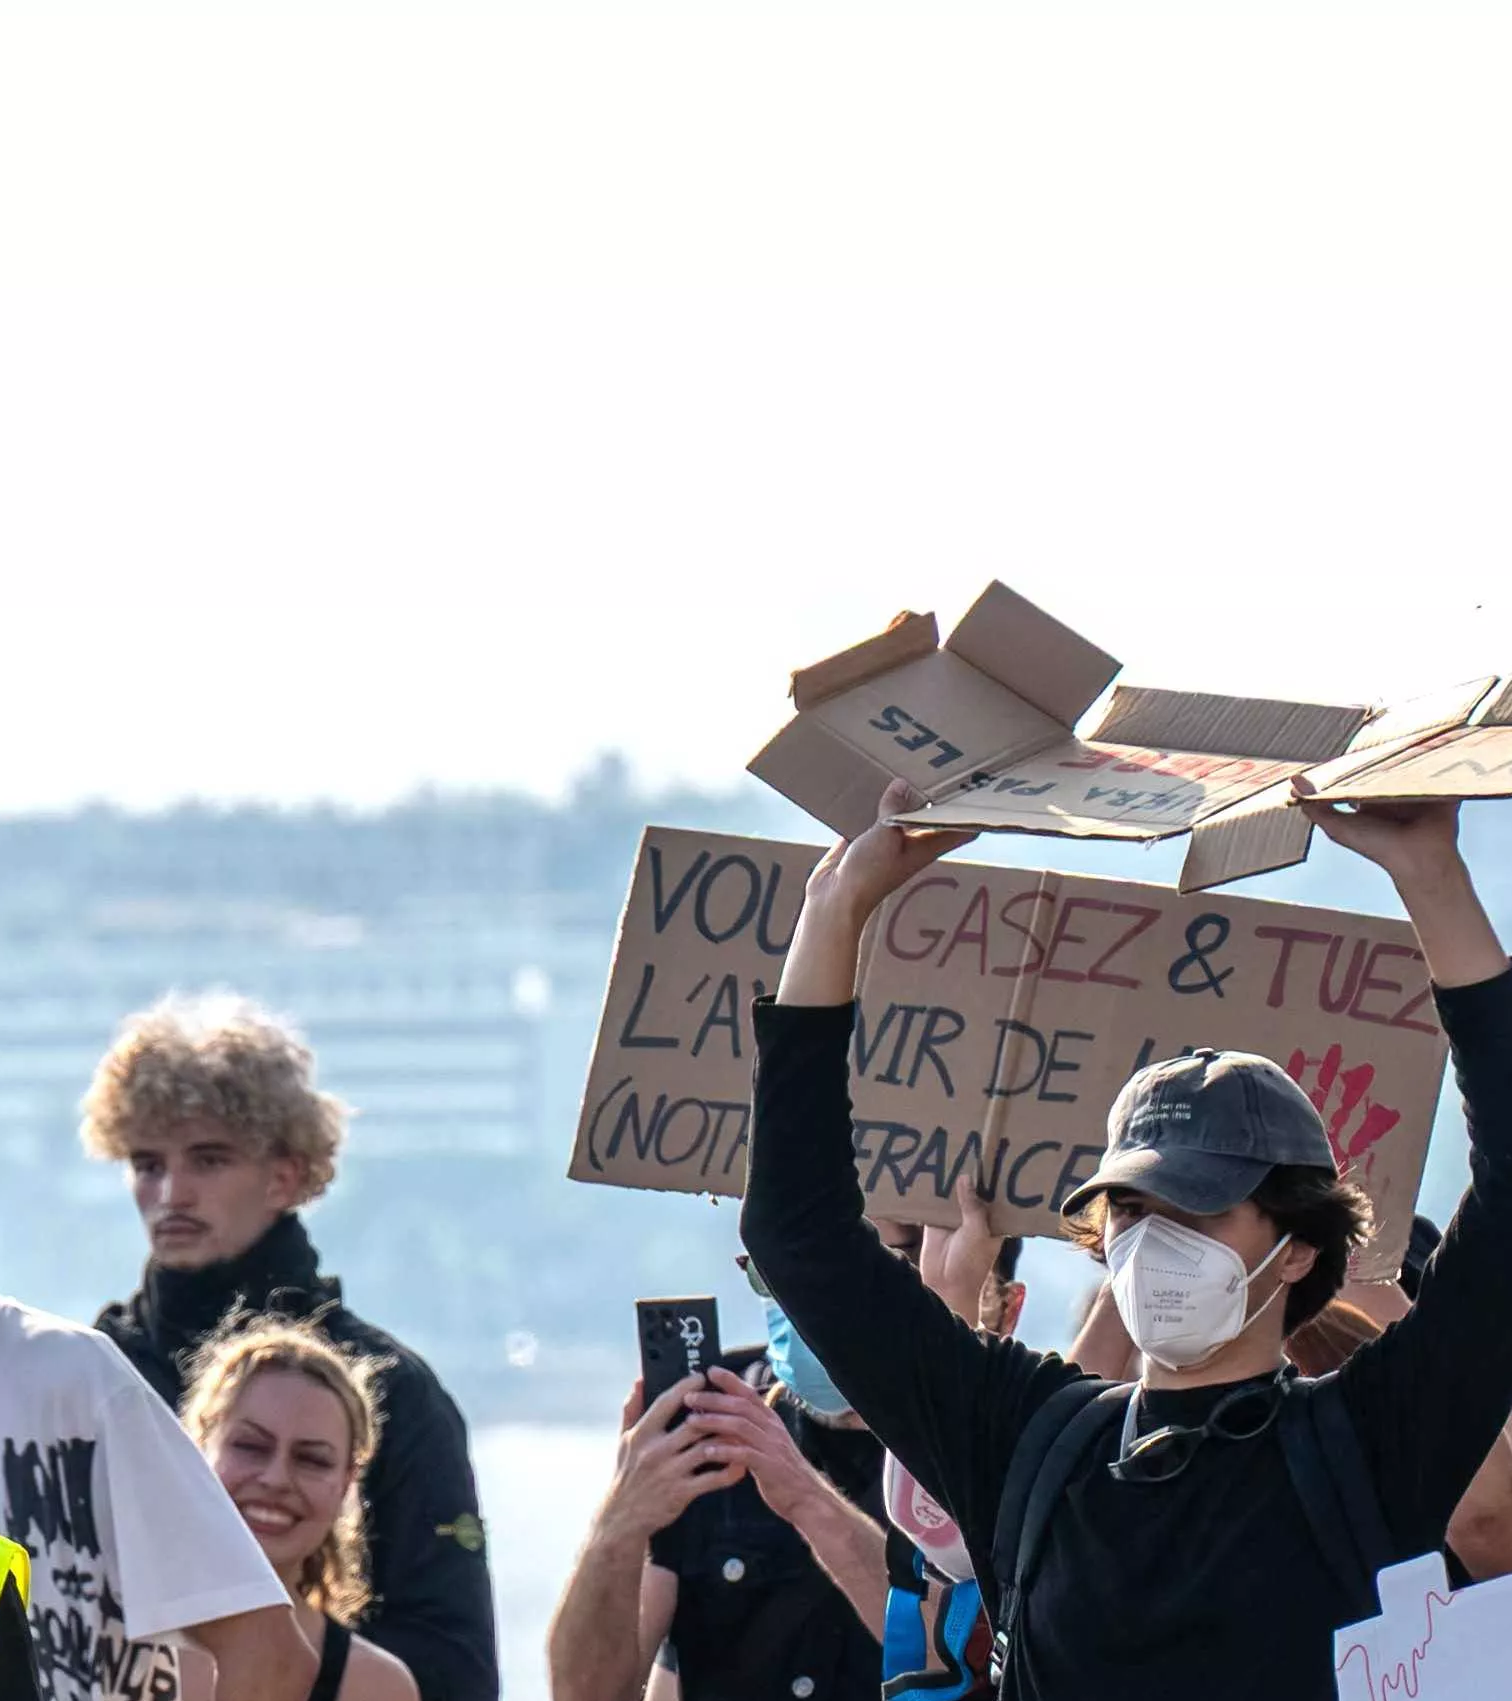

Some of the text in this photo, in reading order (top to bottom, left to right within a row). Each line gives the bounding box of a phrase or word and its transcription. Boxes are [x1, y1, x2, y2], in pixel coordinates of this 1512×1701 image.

[869, 704, 964, 769] LES
[649, 845, 1440, 1036] VOU GASEZ & TUEZ
[983, 1016, 1096, 1103] DE
